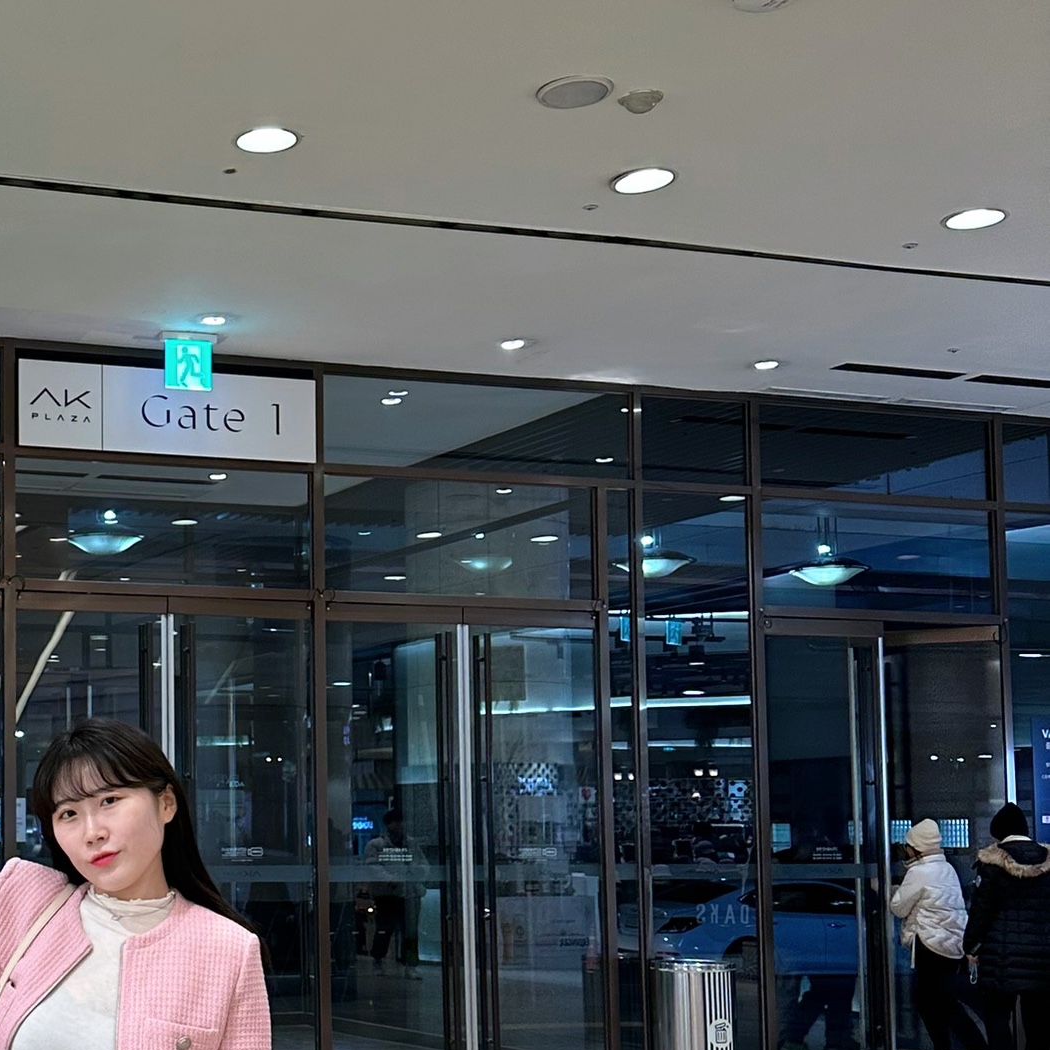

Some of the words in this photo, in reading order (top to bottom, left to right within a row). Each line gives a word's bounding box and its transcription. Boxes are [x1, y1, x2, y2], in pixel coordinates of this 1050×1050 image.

[29, 387, 92, 409] AK
[31, 411, 92, 424] PLAZA
[140, 394, 246, 433] Gate
[271, 402, 281, 436] 1
